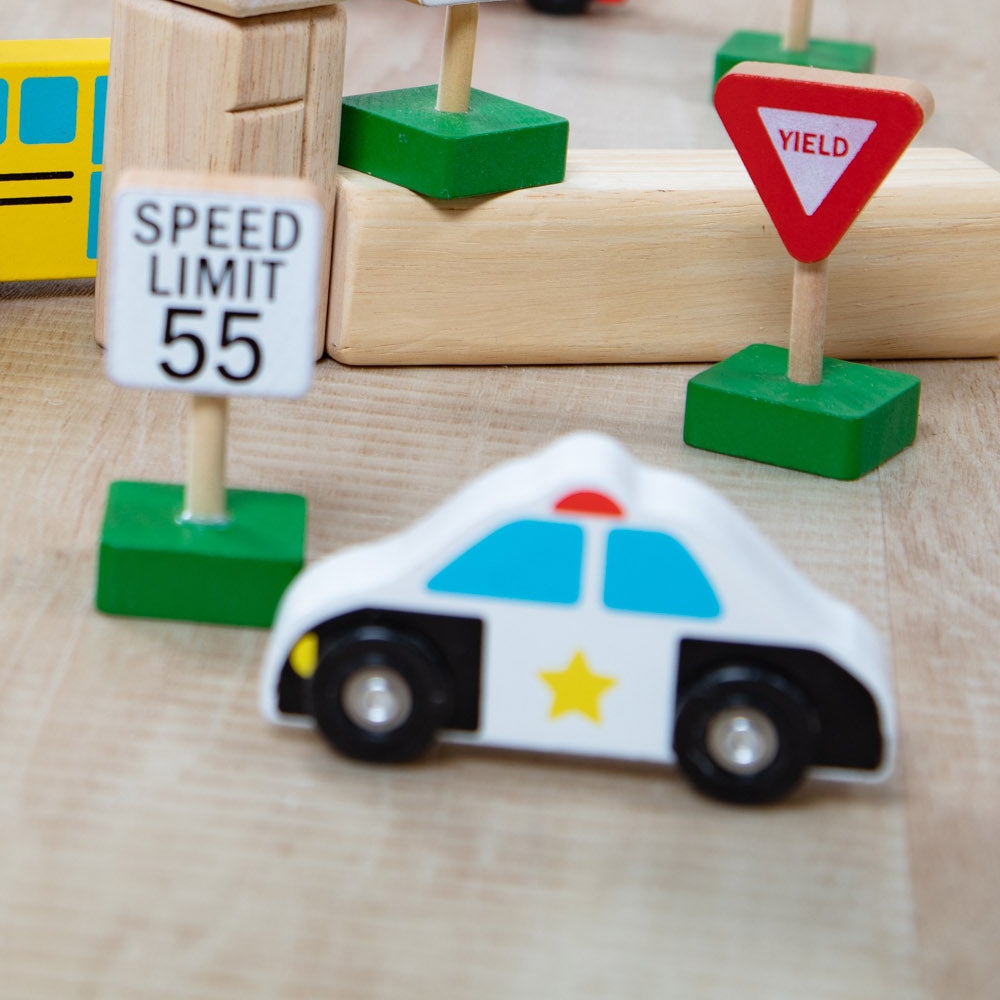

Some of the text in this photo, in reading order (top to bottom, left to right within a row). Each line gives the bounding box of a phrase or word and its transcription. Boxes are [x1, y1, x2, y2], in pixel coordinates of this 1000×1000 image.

[778, 128, 849, 158] YIELD
[133, 200, 302, 251] SPEED
[148, 253, 288, 303] LIMIT
[159, 308, 263, 383] 55
